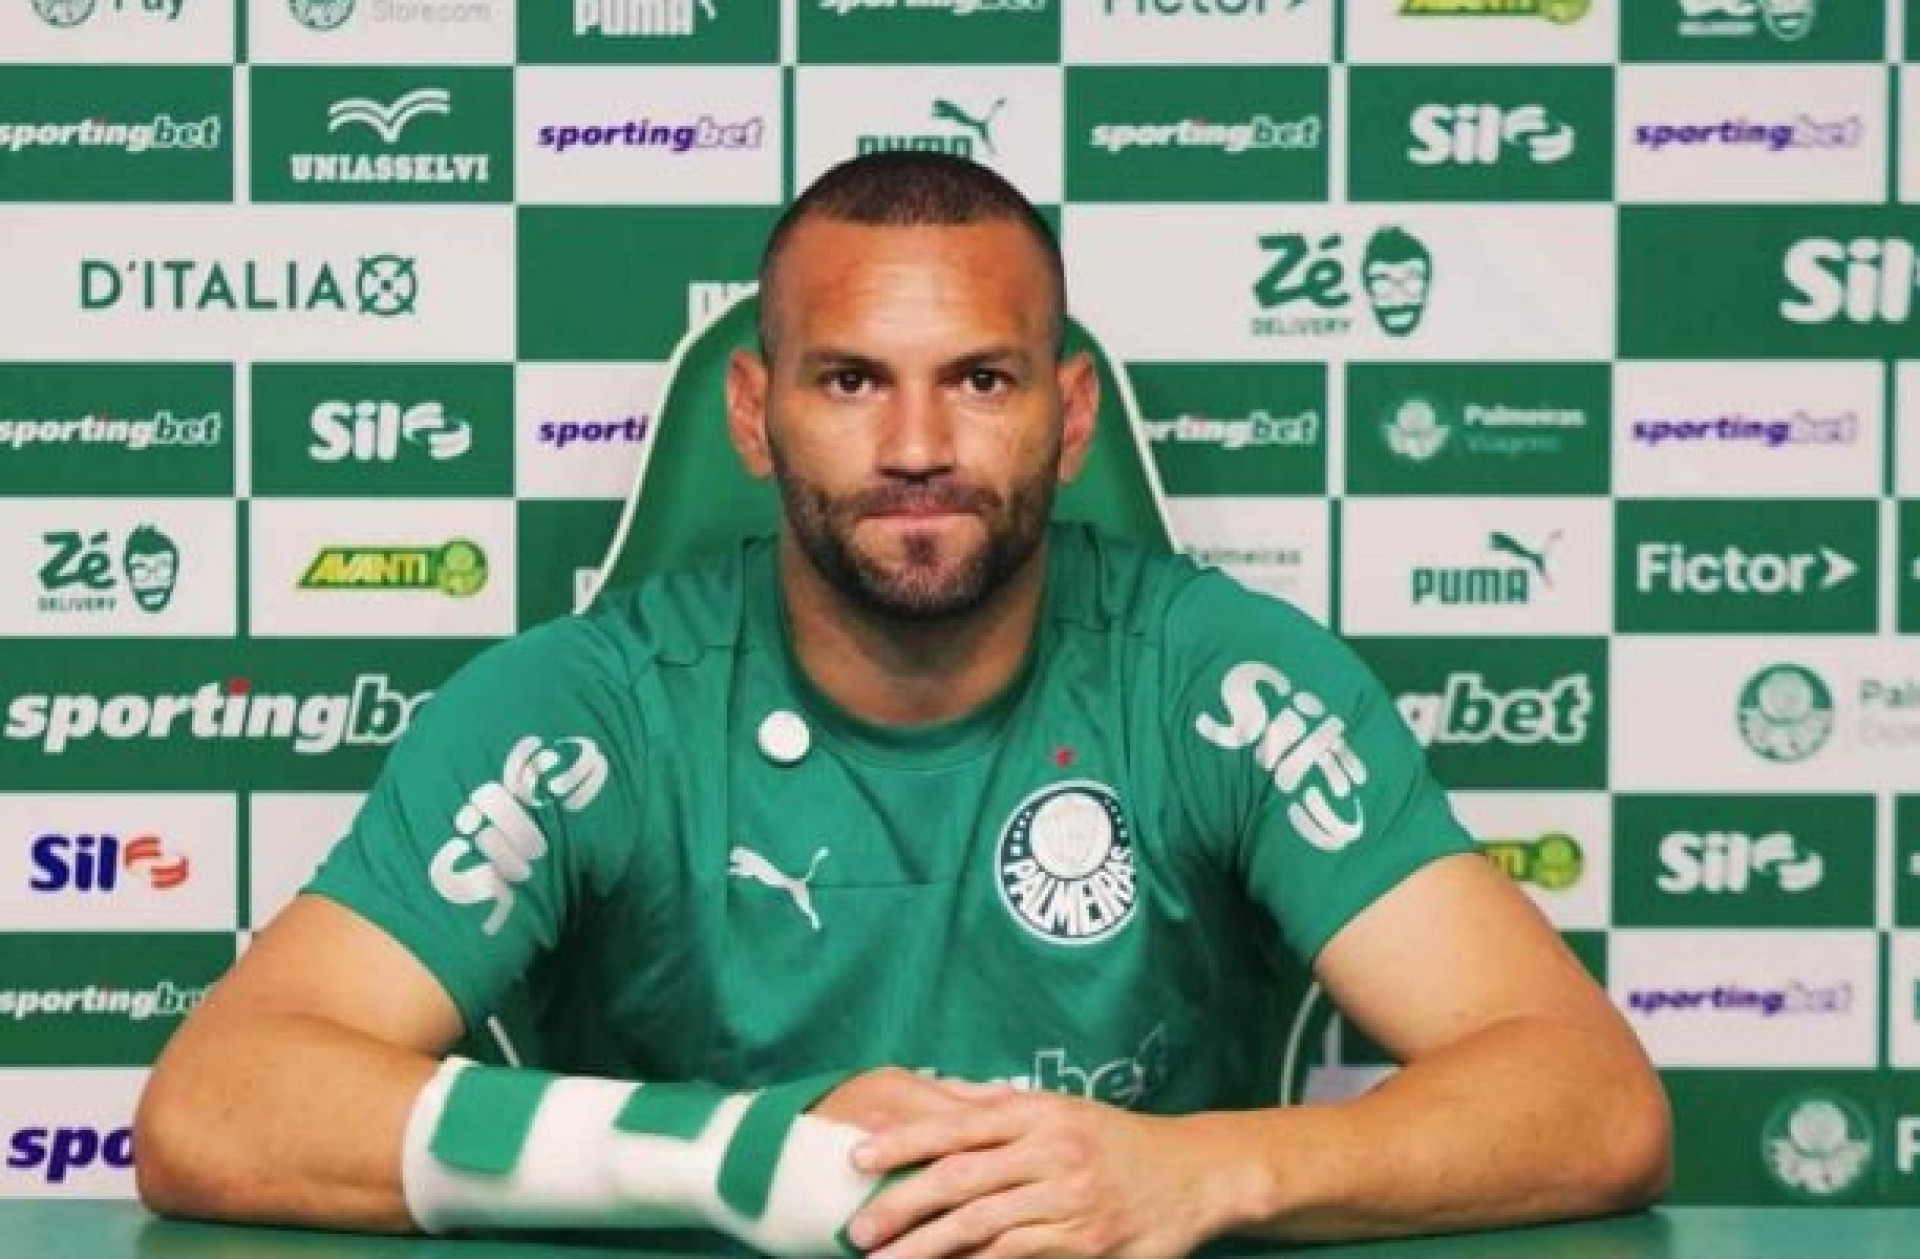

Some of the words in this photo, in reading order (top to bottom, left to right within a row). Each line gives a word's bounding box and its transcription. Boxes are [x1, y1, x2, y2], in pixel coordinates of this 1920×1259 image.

[538, 118, 762, 152] sportingbet
[1090, 115, 1321, 151] sportingbet
[290, 155, 489, 182] UNIASSELVI
[1253, 232, 1351, 309] Zé
[1251, 318, 1353, 337] DELIVERY
[538, 412, 649, 449] sporti
[38, 531, 116, 590] Zé
[312, 551, 428, 584] AVANTI
[1637, 544, 1815, 593] Fictor
[1412, 568, 1530, 604] PUMA
[38, 597, 117, 612] DELIVERY
[29, 834, 119, 892] Sil
